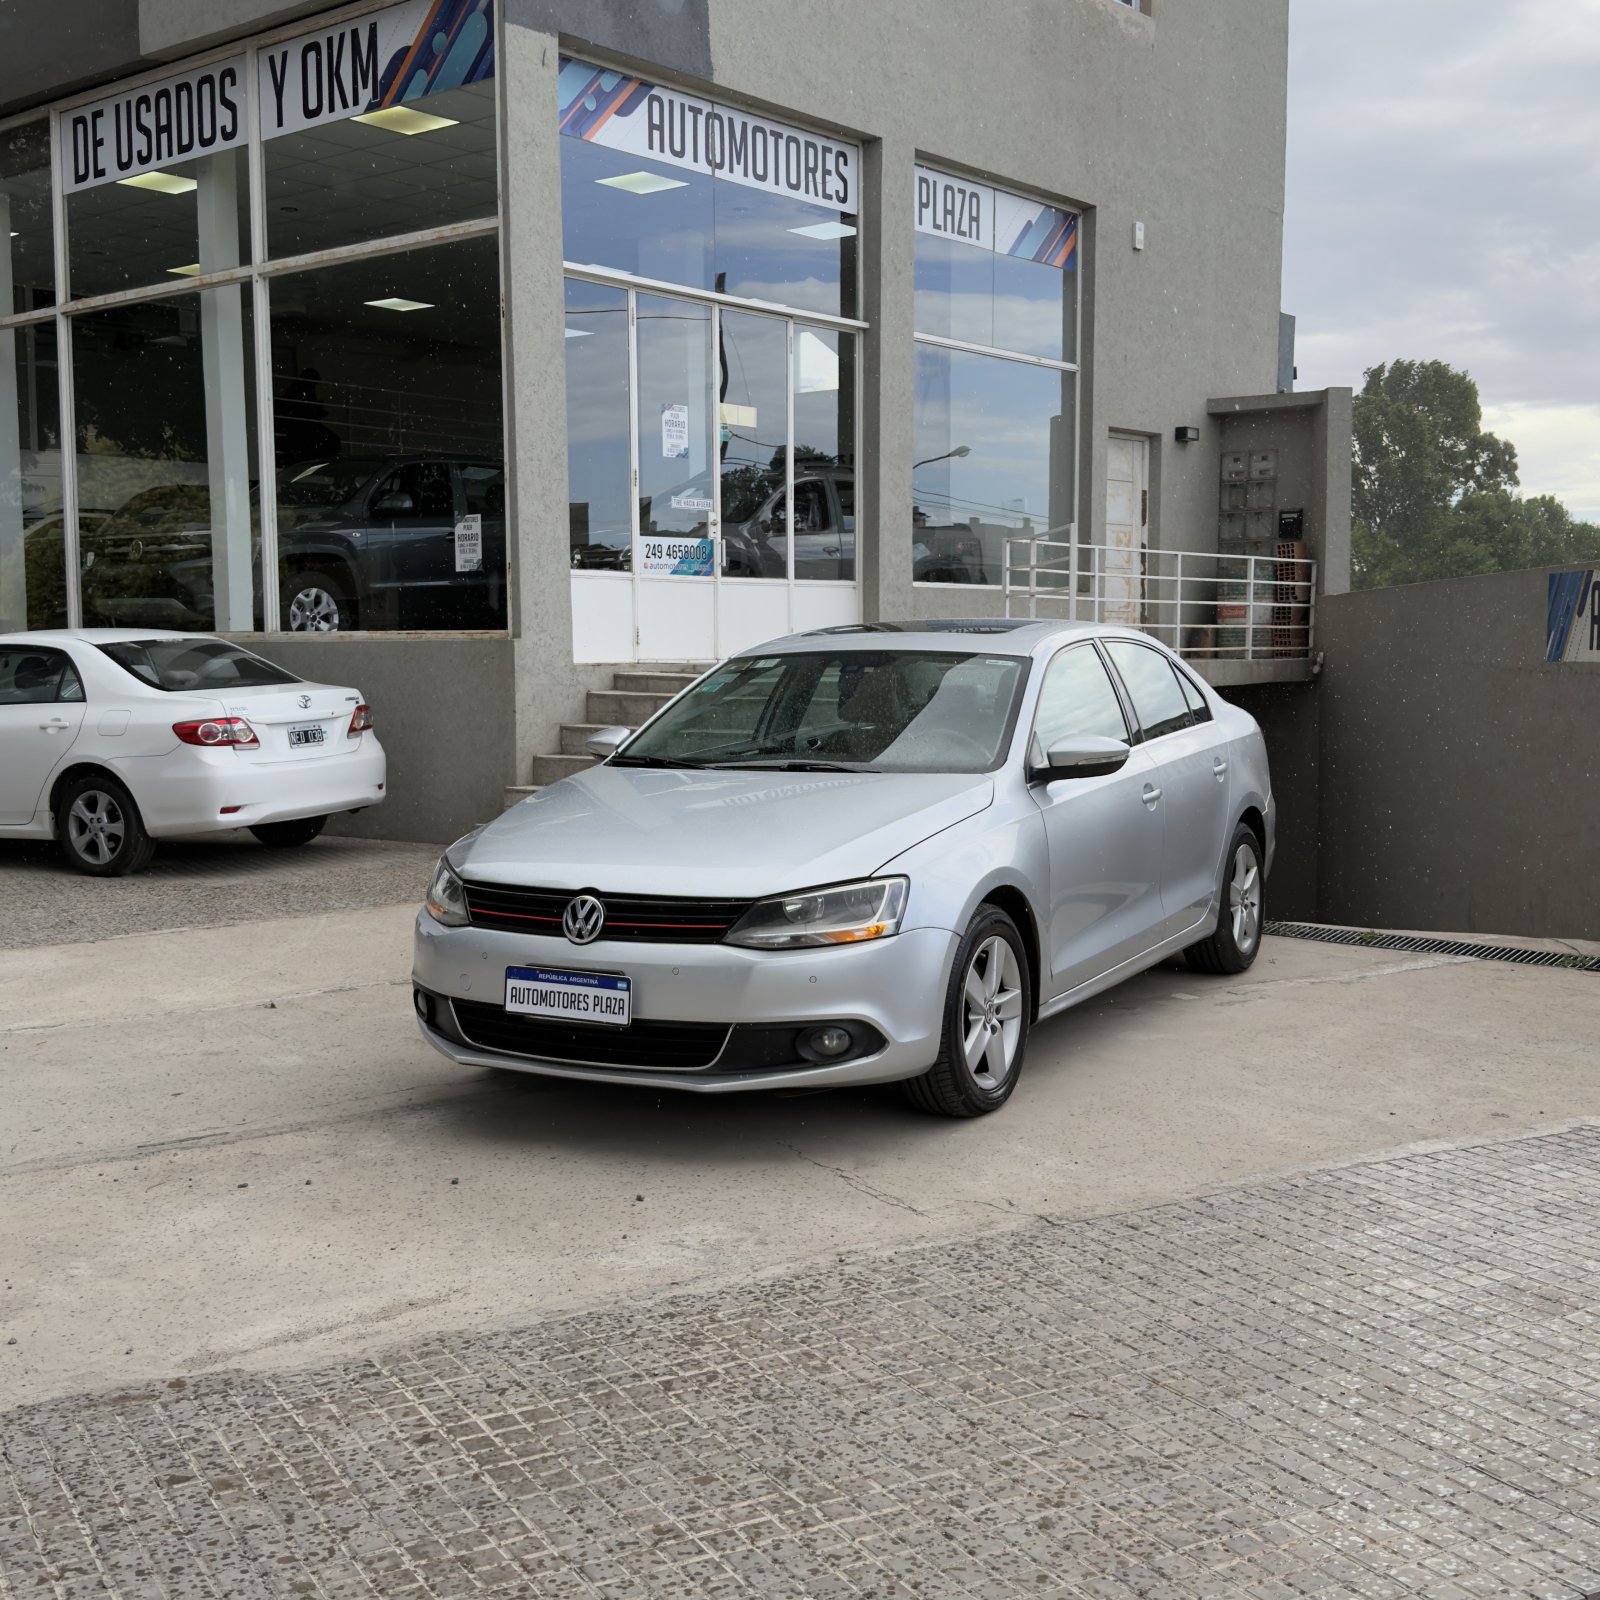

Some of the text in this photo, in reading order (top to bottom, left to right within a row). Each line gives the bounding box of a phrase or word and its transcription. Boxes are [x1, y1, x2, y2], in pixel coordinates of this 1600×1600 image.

[72, 109, 106, 185] DE
[115, 67, 238, 170] USADOS
[268, 50, 289, 128] Y
[647, 93, 981, 241] AUTOMOTORES PLAZA
[457, 533, 479, 543] HORARIO
[645, 543, 707, 561] 249 4658008
[538, 972, 599, 985] REPÚBLICA ARGENTINA
[510, 986, 625, 1016] AUTOMOTORES PLAZA
